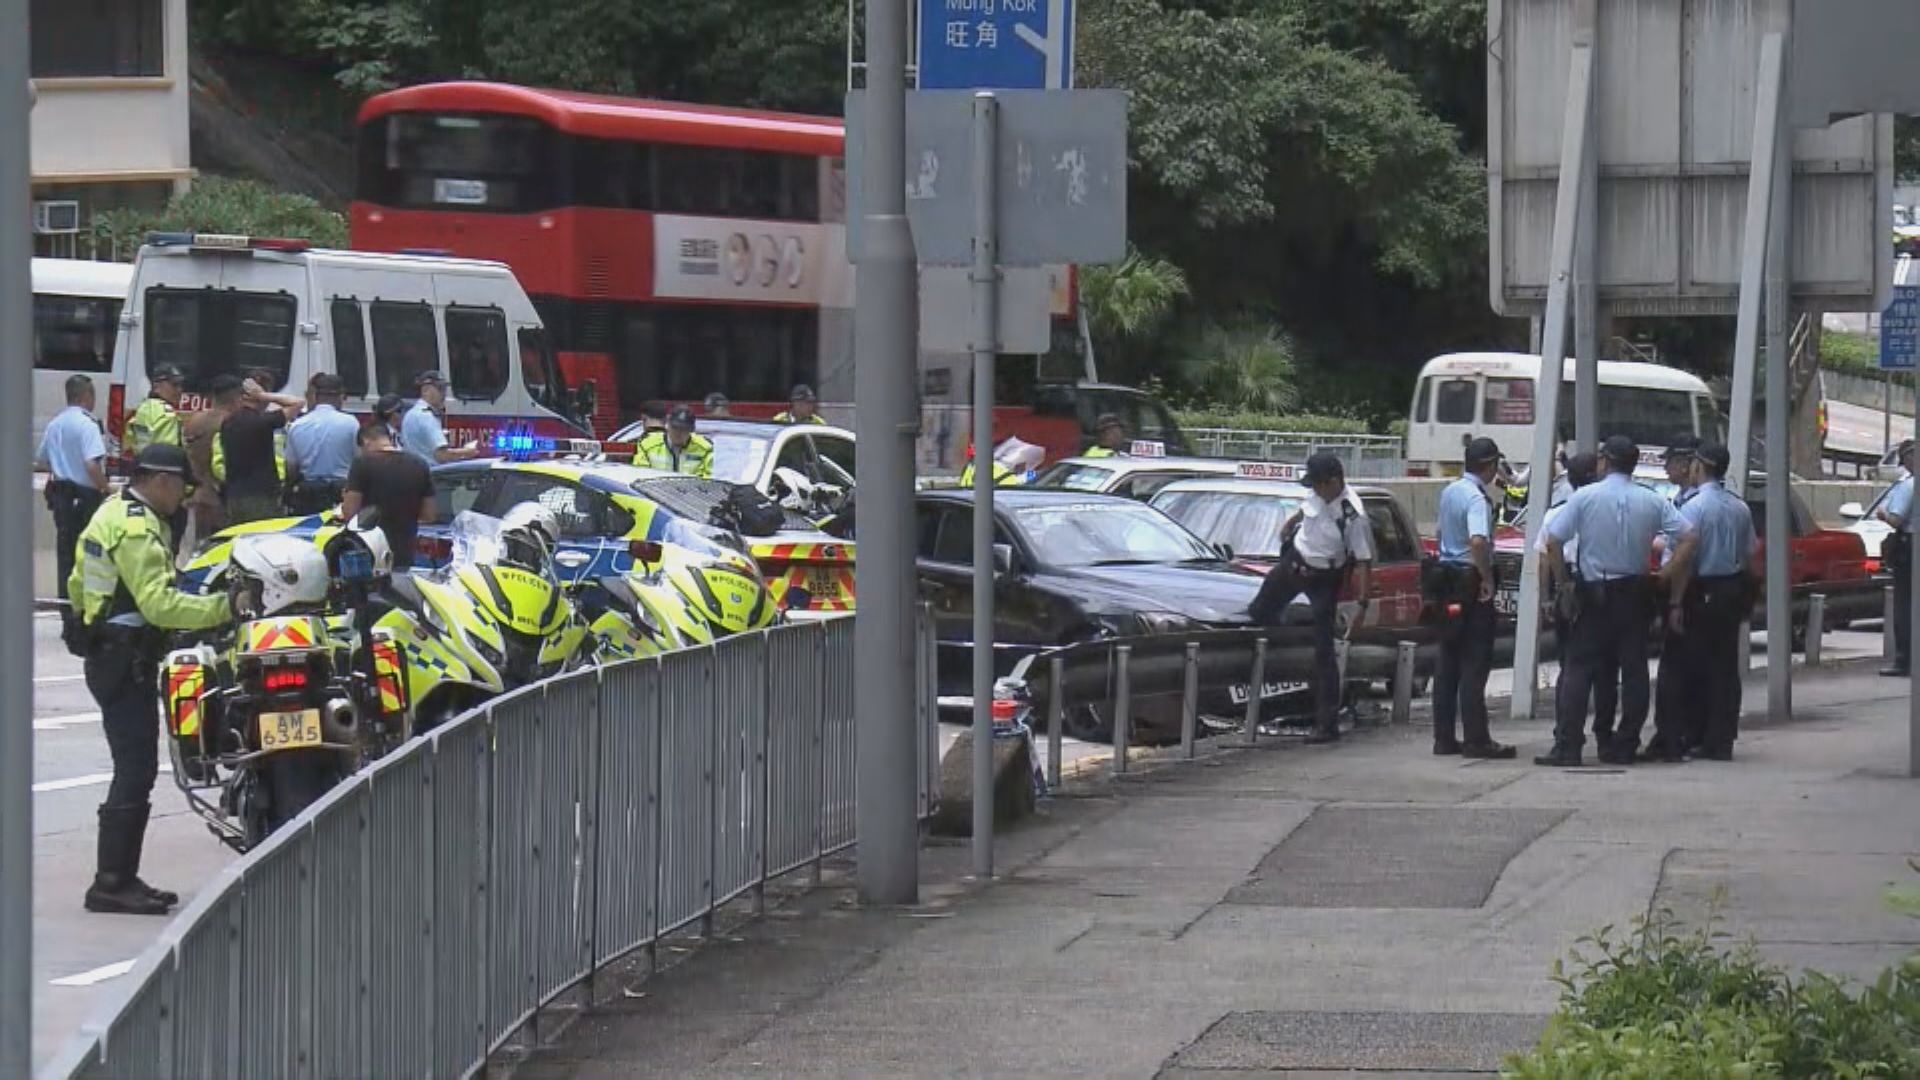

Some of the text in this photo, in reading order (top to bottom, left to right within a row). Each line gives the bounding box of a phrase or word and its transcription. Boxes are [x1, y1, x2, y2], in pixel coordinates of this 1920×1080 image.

[945, 0, 1036, 15] Mong Kok
[946, 21, 998, 48] 旺角
[277, 713, 304, 733] AM
[263, 726, 318, 746] 6345
